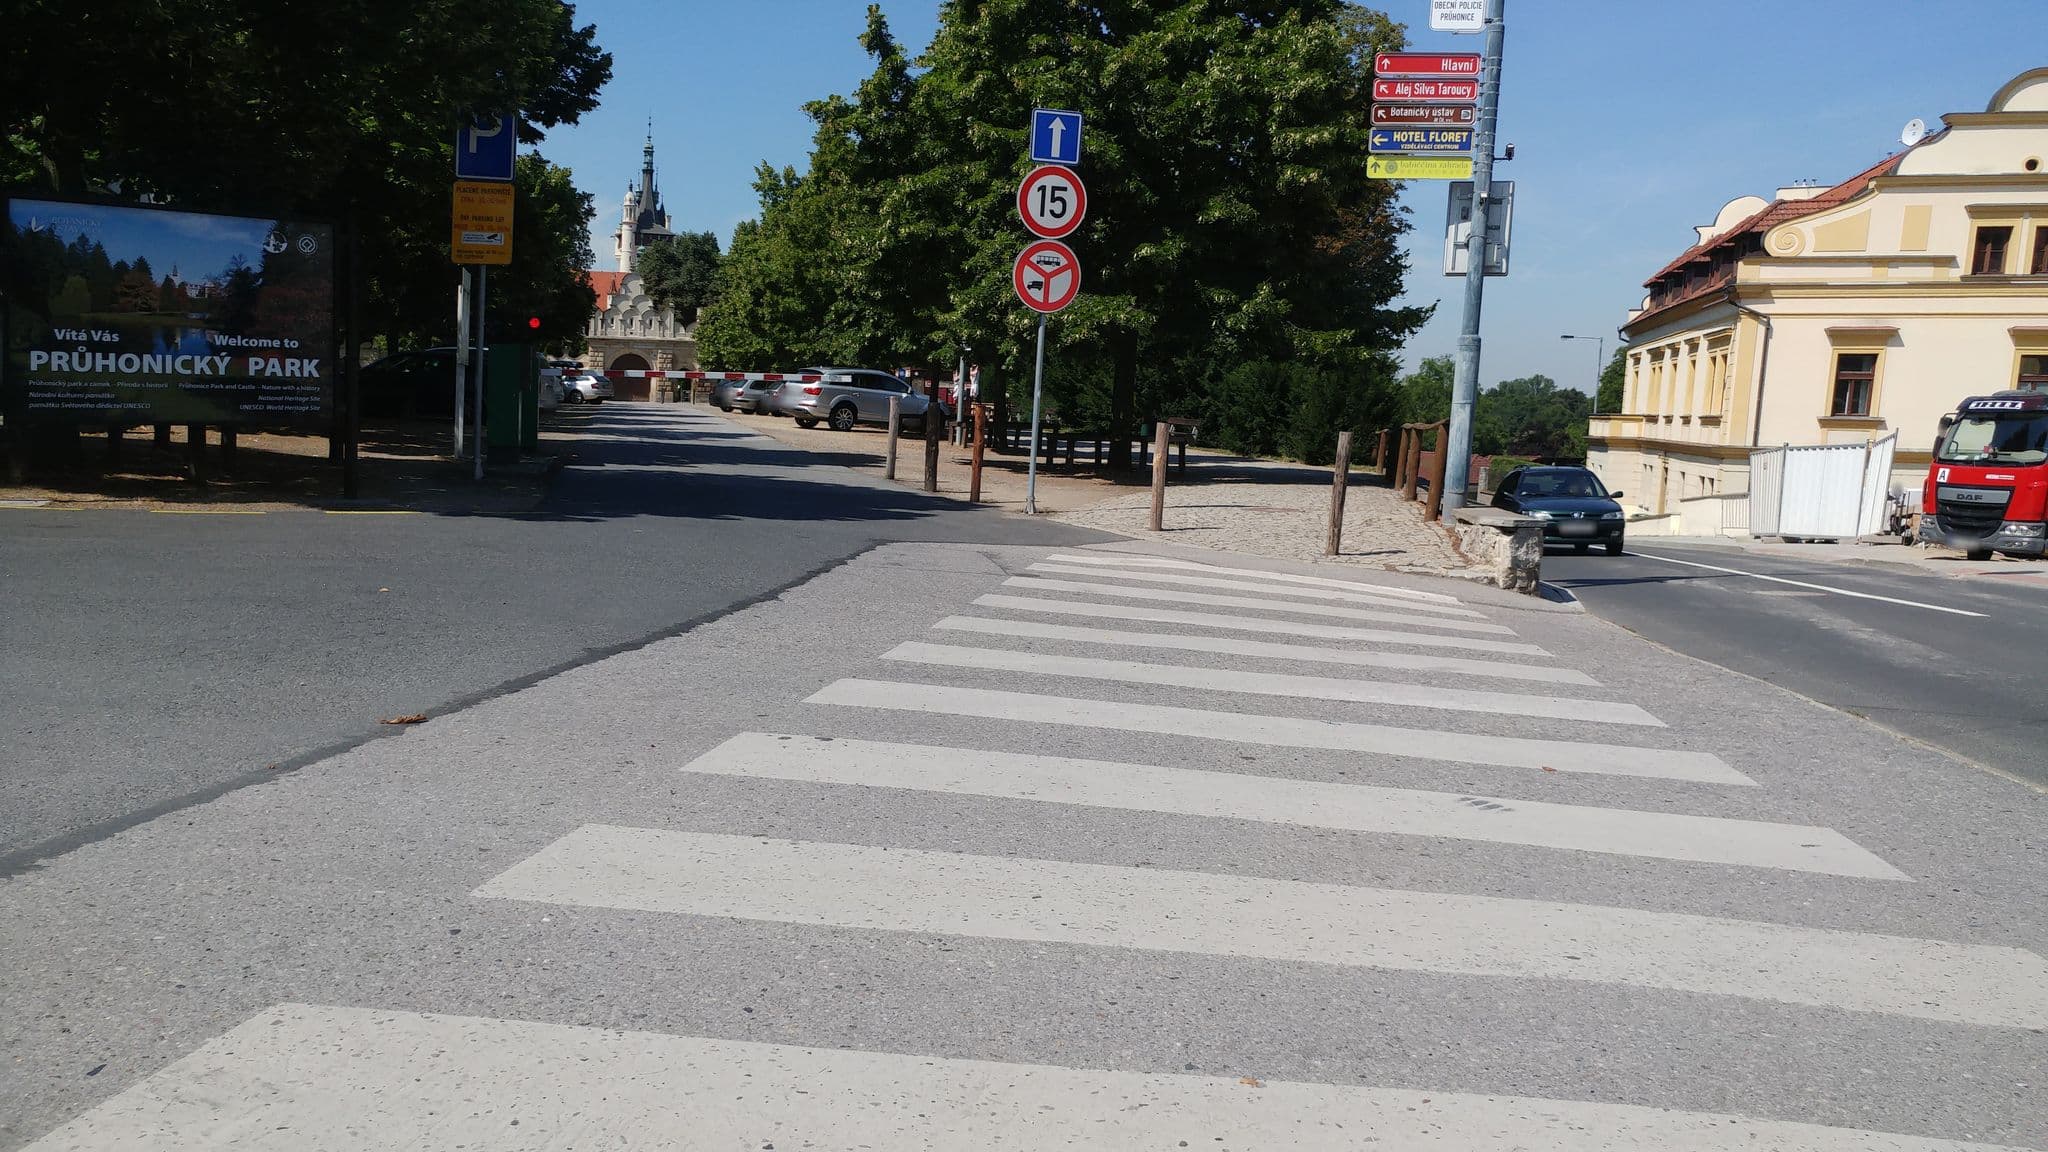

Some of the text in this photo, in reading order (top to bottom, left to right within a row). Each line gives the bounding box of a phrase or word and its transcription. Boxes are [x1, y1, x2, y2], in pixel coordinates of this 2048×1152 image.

[1434, 1, 1483, 10] OBECNÍ POLICIE
[1441, 58, 1474, 71] Hlavní
[1395, 83, 1472, 98] Alej Silva Taroucy
[1390, 106, 1455, 118] Botanický ústav
[1392, 131, 1469, 143] HOTEL FLORET
[1037, 184, 1068, 219] 15
[54, 328, 120, 342] Vítá Vás
[214, 334, 299, 349] Welcome to
[30, 346, 320, 378] PRŮHONICKÝ PARK
[1939, 469, 1946, 481] A
[1956, 493, 1983, 501] DAF
